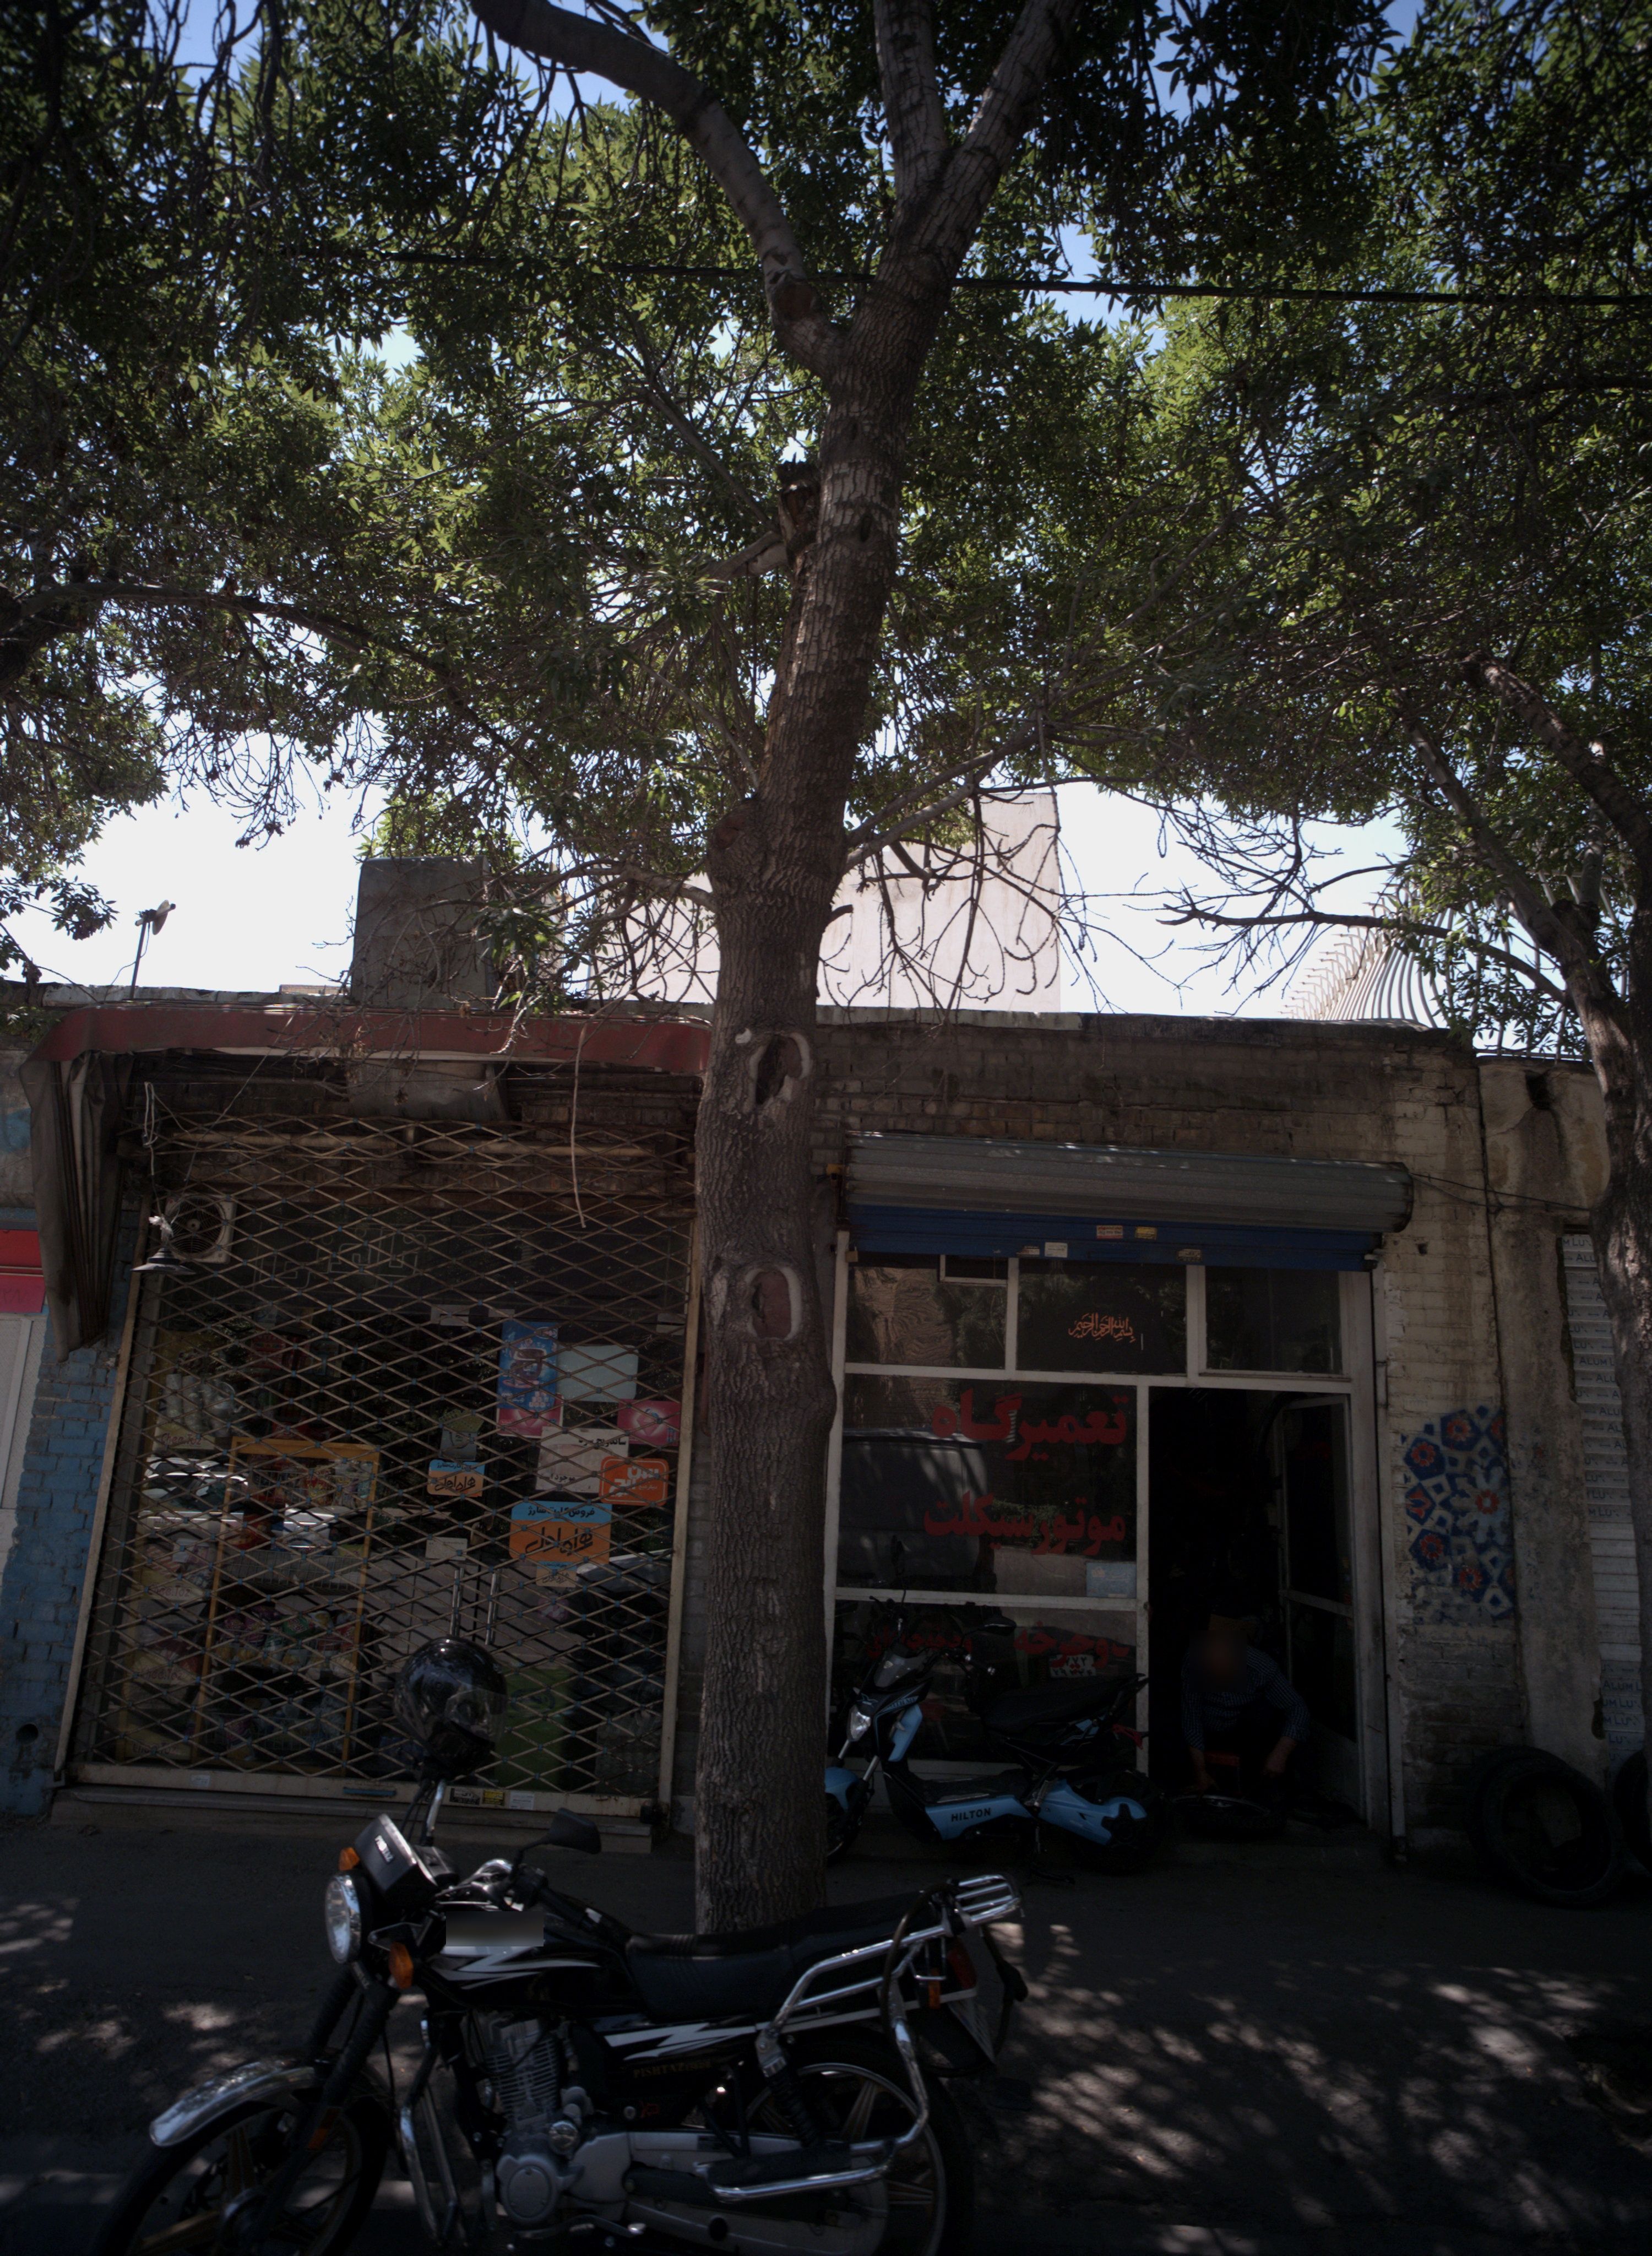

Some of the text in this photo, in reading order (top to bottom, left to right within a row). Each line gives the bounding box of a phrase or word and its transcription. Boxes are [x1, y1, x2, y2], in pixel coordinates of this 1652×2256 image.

[1114, 1314, 1129, 1331] الله
[1113, 1326, 1137, 1343] بسم
[932, 1388, 1130, 1461] تعمیرگاه
[568, 1507, 595, 1517] فروش
[951, 1807, 991, 1822] HILTON
